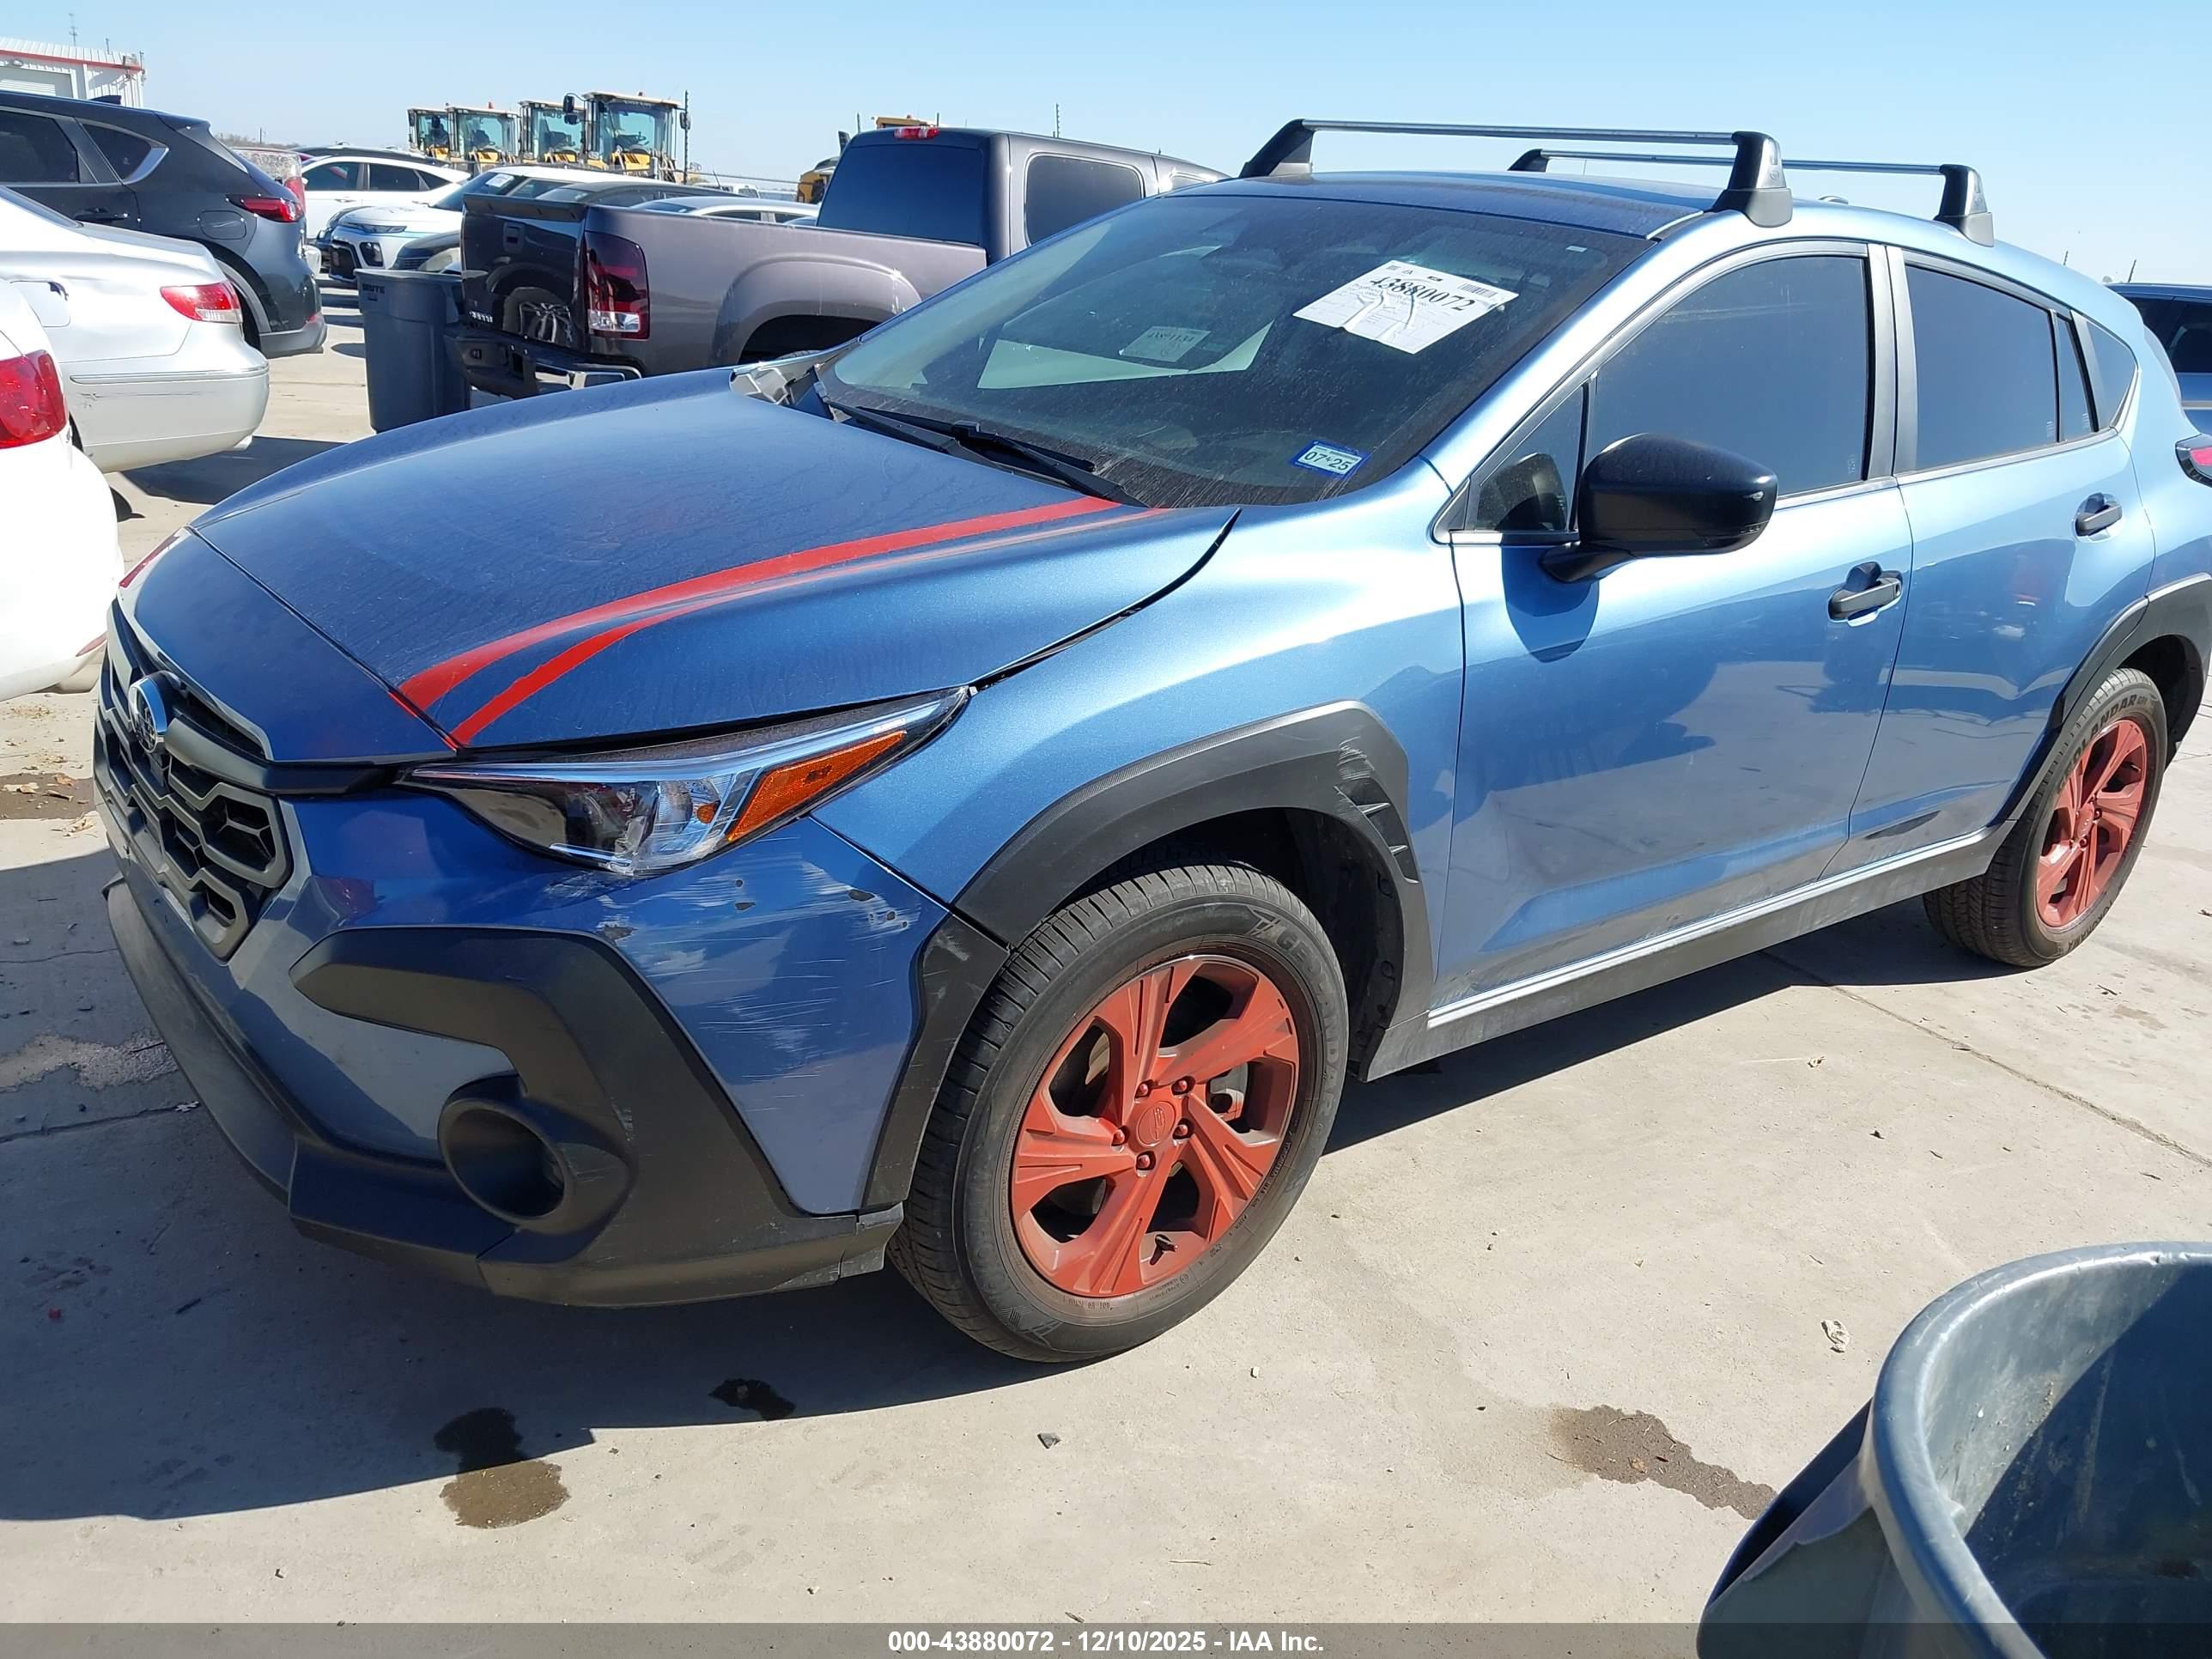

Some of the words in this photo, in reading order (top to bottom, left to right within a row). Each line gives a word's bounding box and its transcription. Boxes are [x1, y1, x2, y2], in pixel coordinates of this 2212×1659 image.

[1370, 276, 1475, 311] 43880072
[1304, 451, 1326, 462] 07
[1328, 458, 1352, 471] 25
